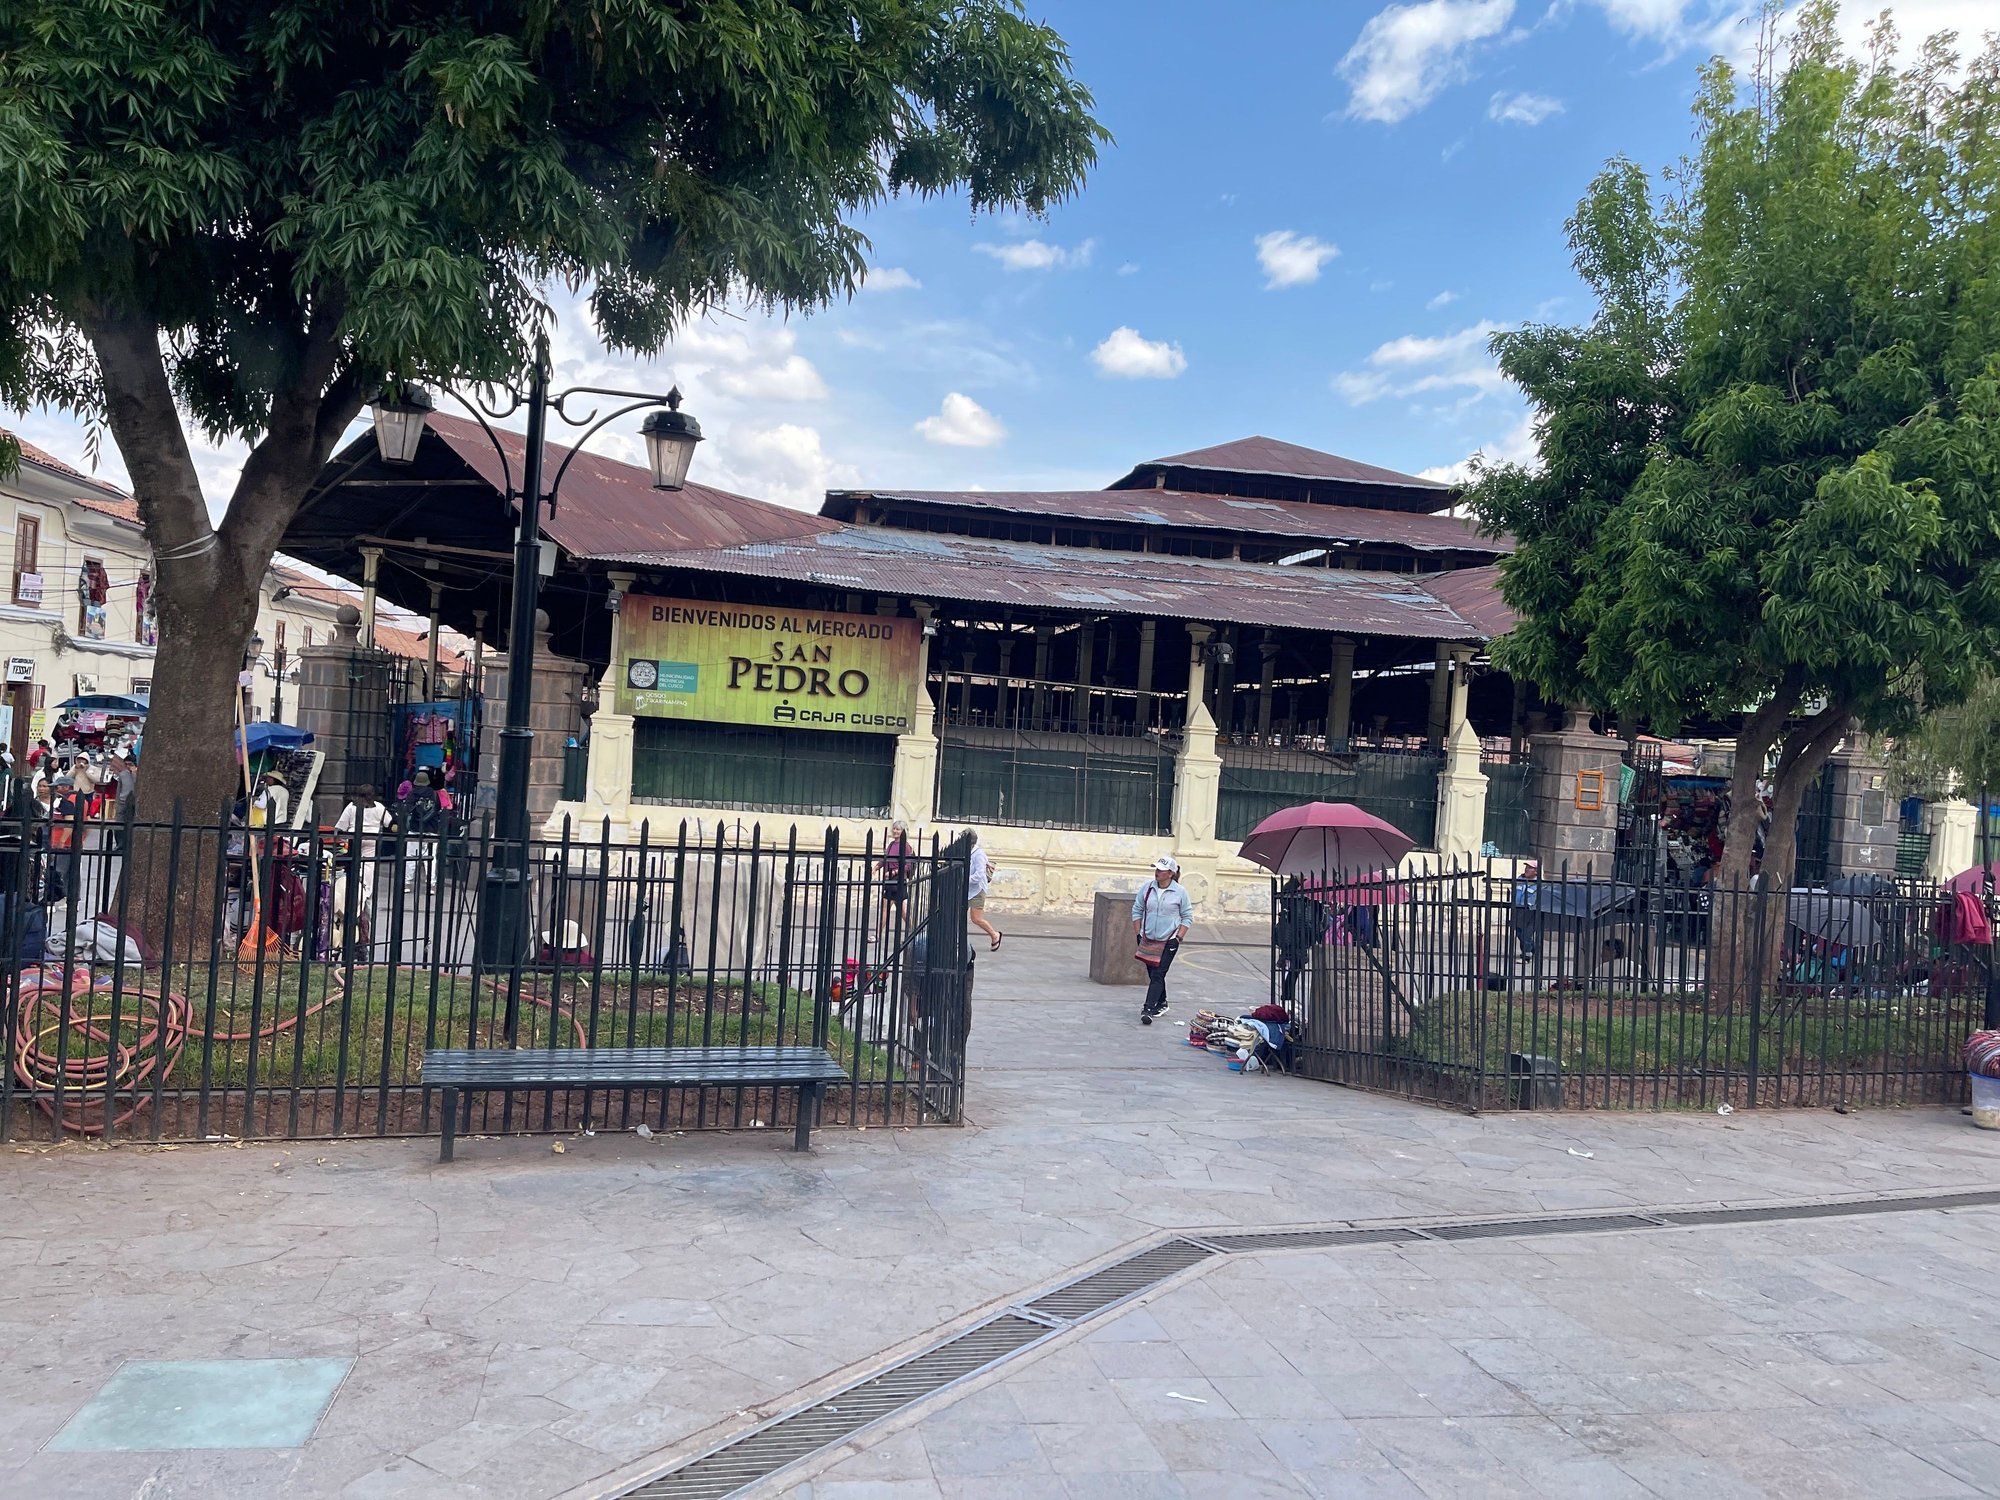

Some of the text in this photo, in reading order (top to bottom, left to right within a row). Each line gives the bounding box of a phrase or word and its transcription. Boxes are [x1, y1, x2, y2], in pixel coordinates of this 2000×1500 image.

[652, 605, 893, 641] BIENVENIDOS AL MERCADO
[772, 641, 833, 663] SAN
[727, 656, 870, 698] PEDRO
[799, 710, 907, 728] CAJA CUSCO
